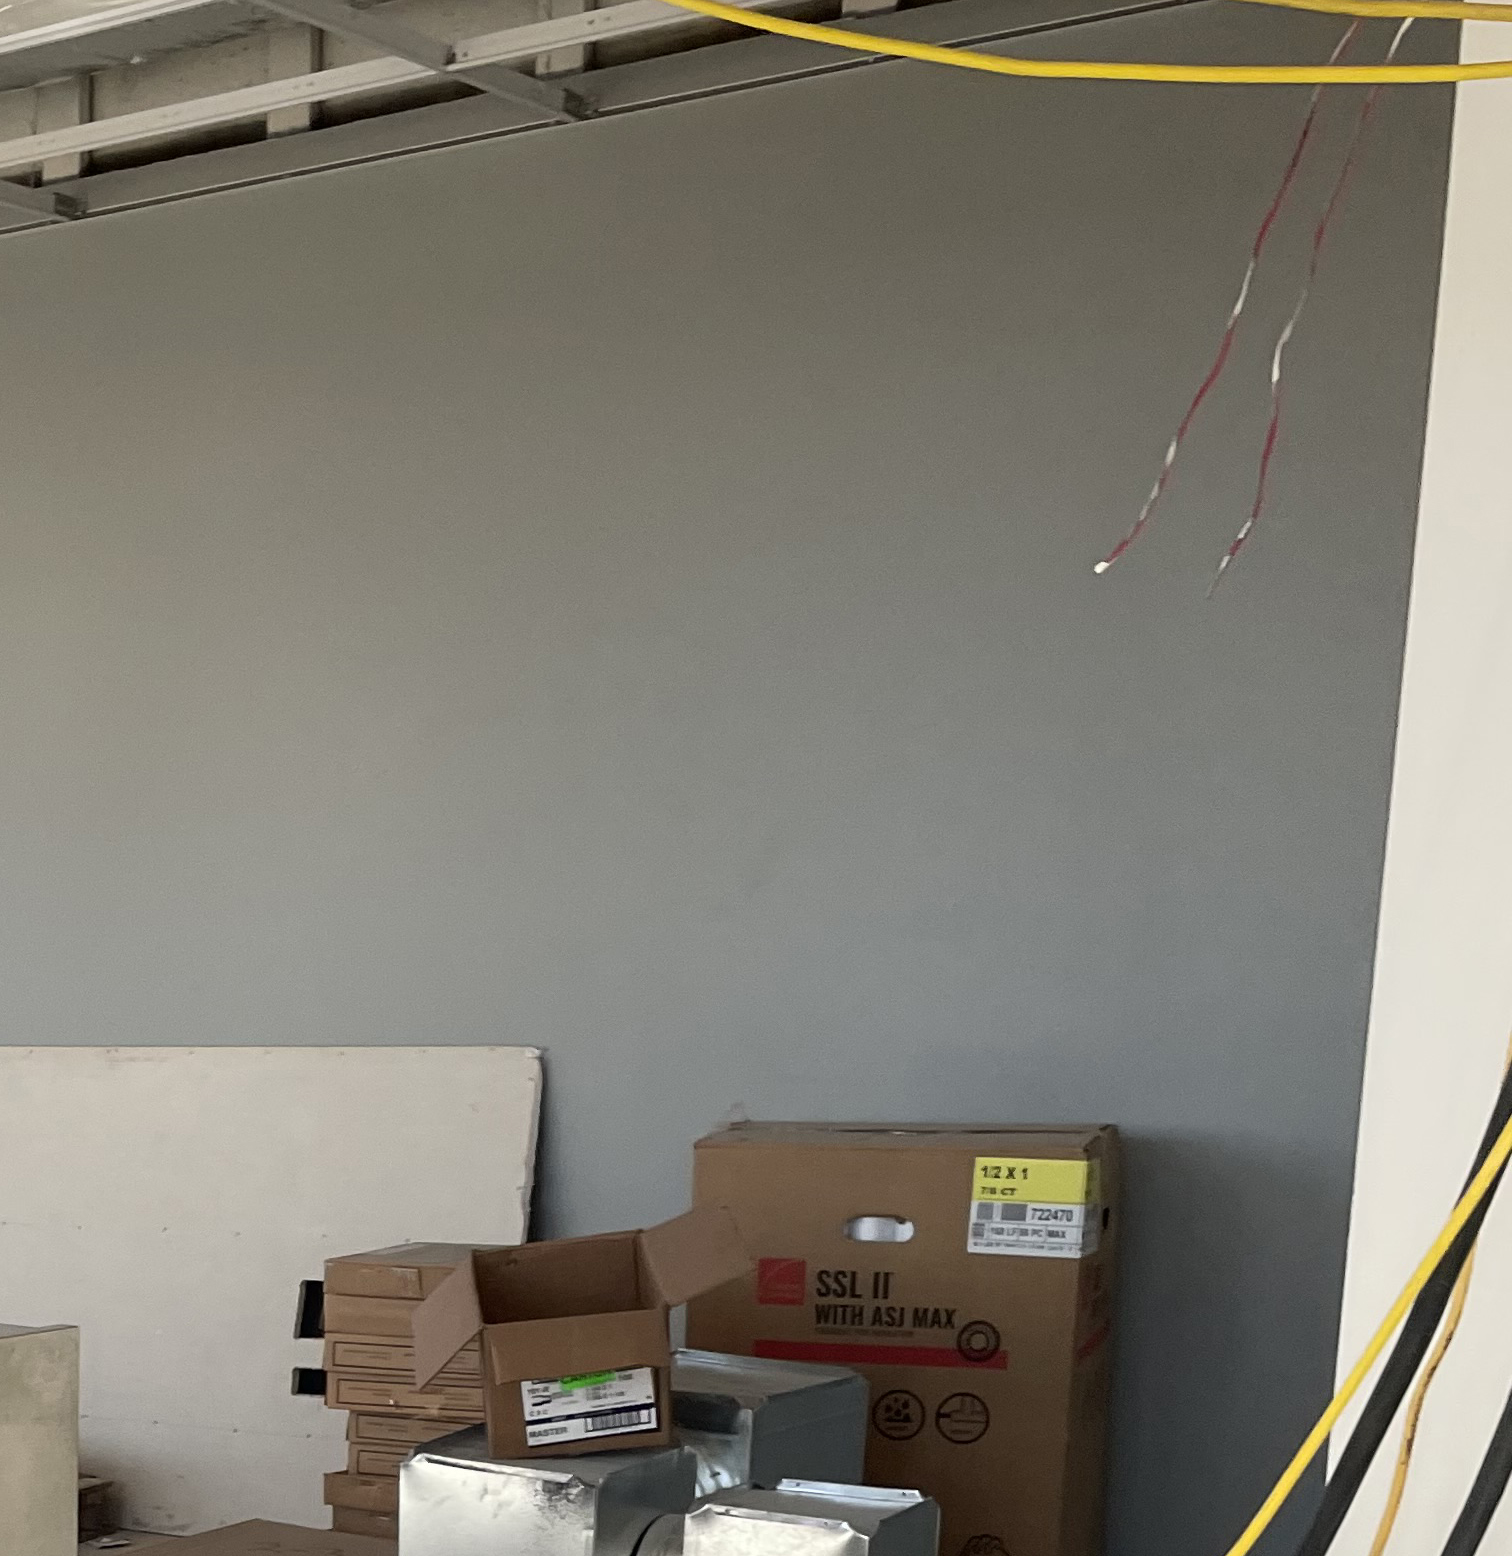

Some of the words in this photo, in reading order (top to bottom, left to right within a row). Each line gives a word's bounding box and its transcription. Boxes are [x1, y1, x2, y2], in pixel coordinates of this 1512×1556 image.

[1021, 1167, 1029, 1180] 1
[1031, 1207, 1074, 1222] 722470
[815, 1269, 863, 1300] SSL
[814, 1302, 865, 1328] WITH
[871, 1304, 906, 1329] ASJ
[912, 1306, 958, 1330] MAX
[528, 1426, 568, 1439] MASTER
